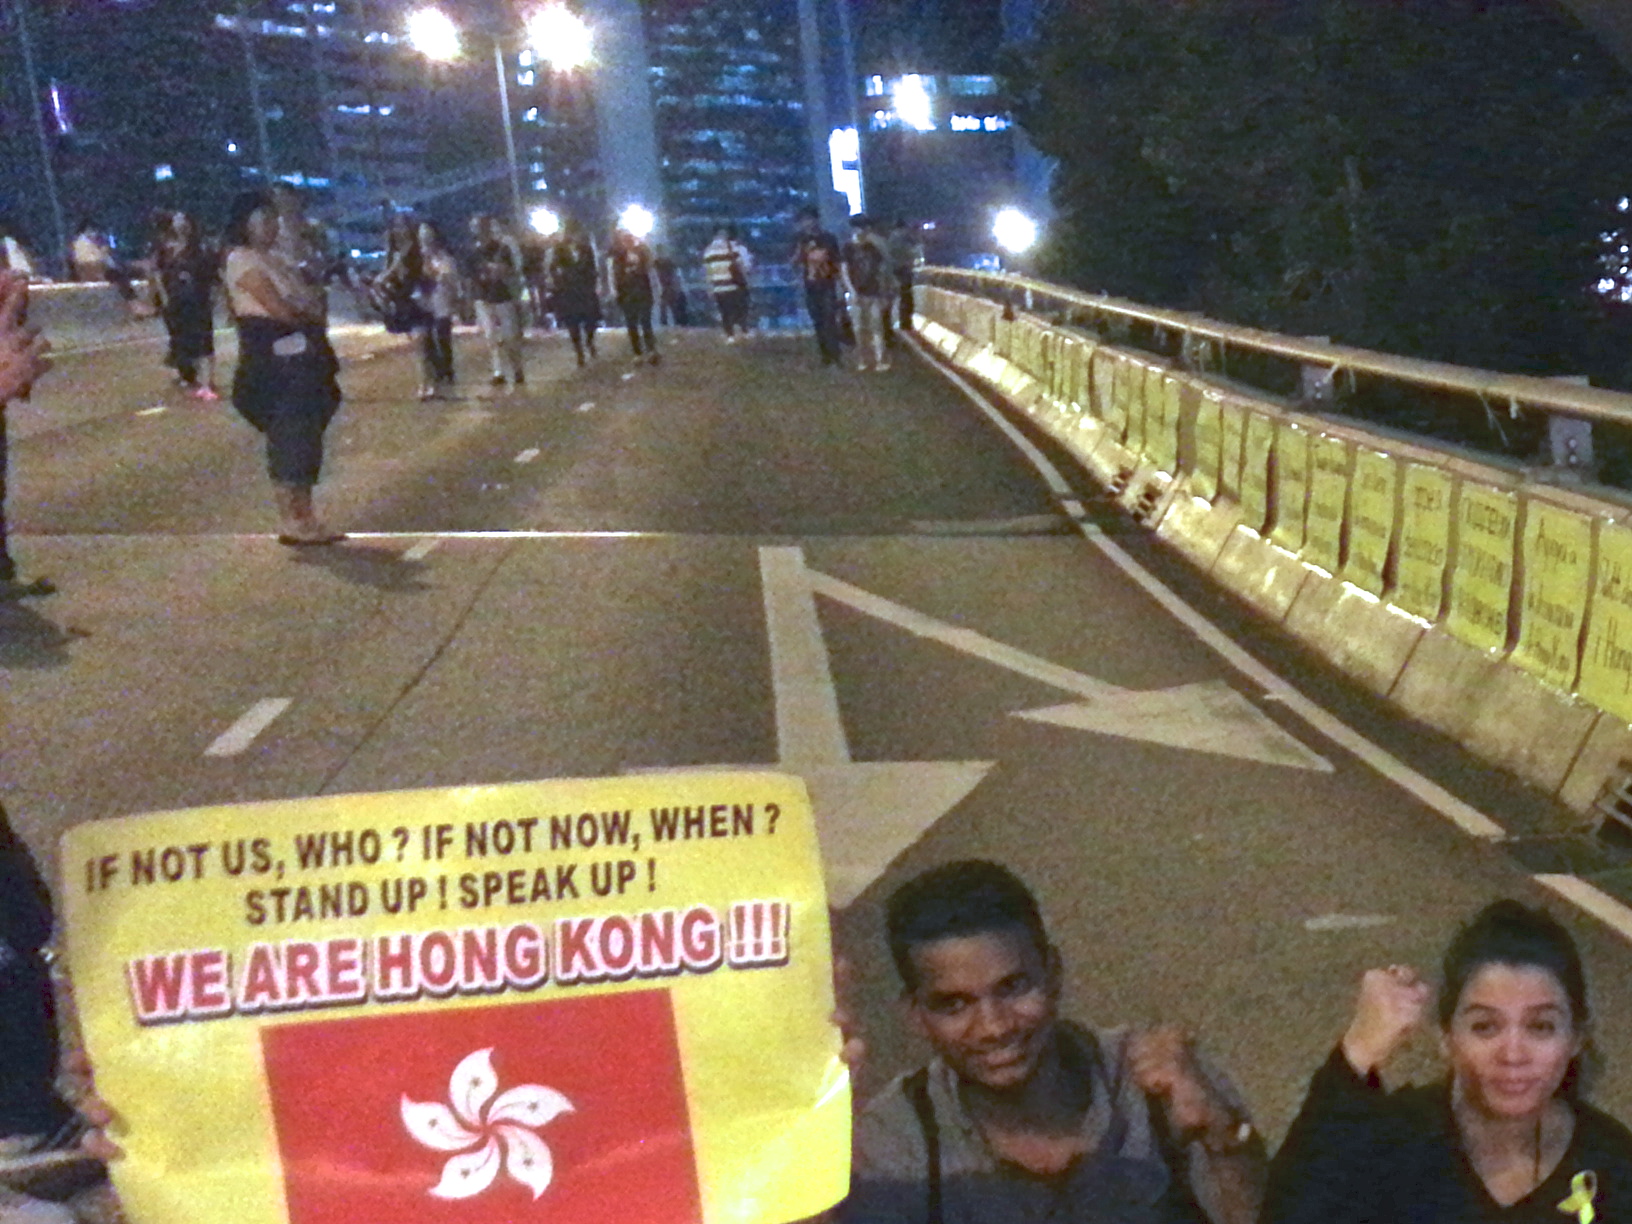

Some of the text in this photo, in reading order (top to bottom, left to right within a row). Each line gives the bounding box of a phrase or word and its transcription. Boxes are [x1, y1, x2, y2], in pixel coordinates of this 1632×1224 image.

[85, 853, 119, 894] IF
[130, 842, 211, 887] NOT
[220, 837, 286, 881] US,
[294, 828, 382, 869] WHO
[423, 823, 454, 860] IF
[465, 817, 539, 858] NOT
[549, 809, 641, 852] NOW,
[650, 803, 754, 843] WHEN
[245, 880, 370, 926] STAND
[380, 876, 429, 915] UP
[460, 863, 581, 909] SPEAK
[590, 859, 637, 898] UP
[130, 900, 790, 1022] WE ARE HONG KONG !!!
